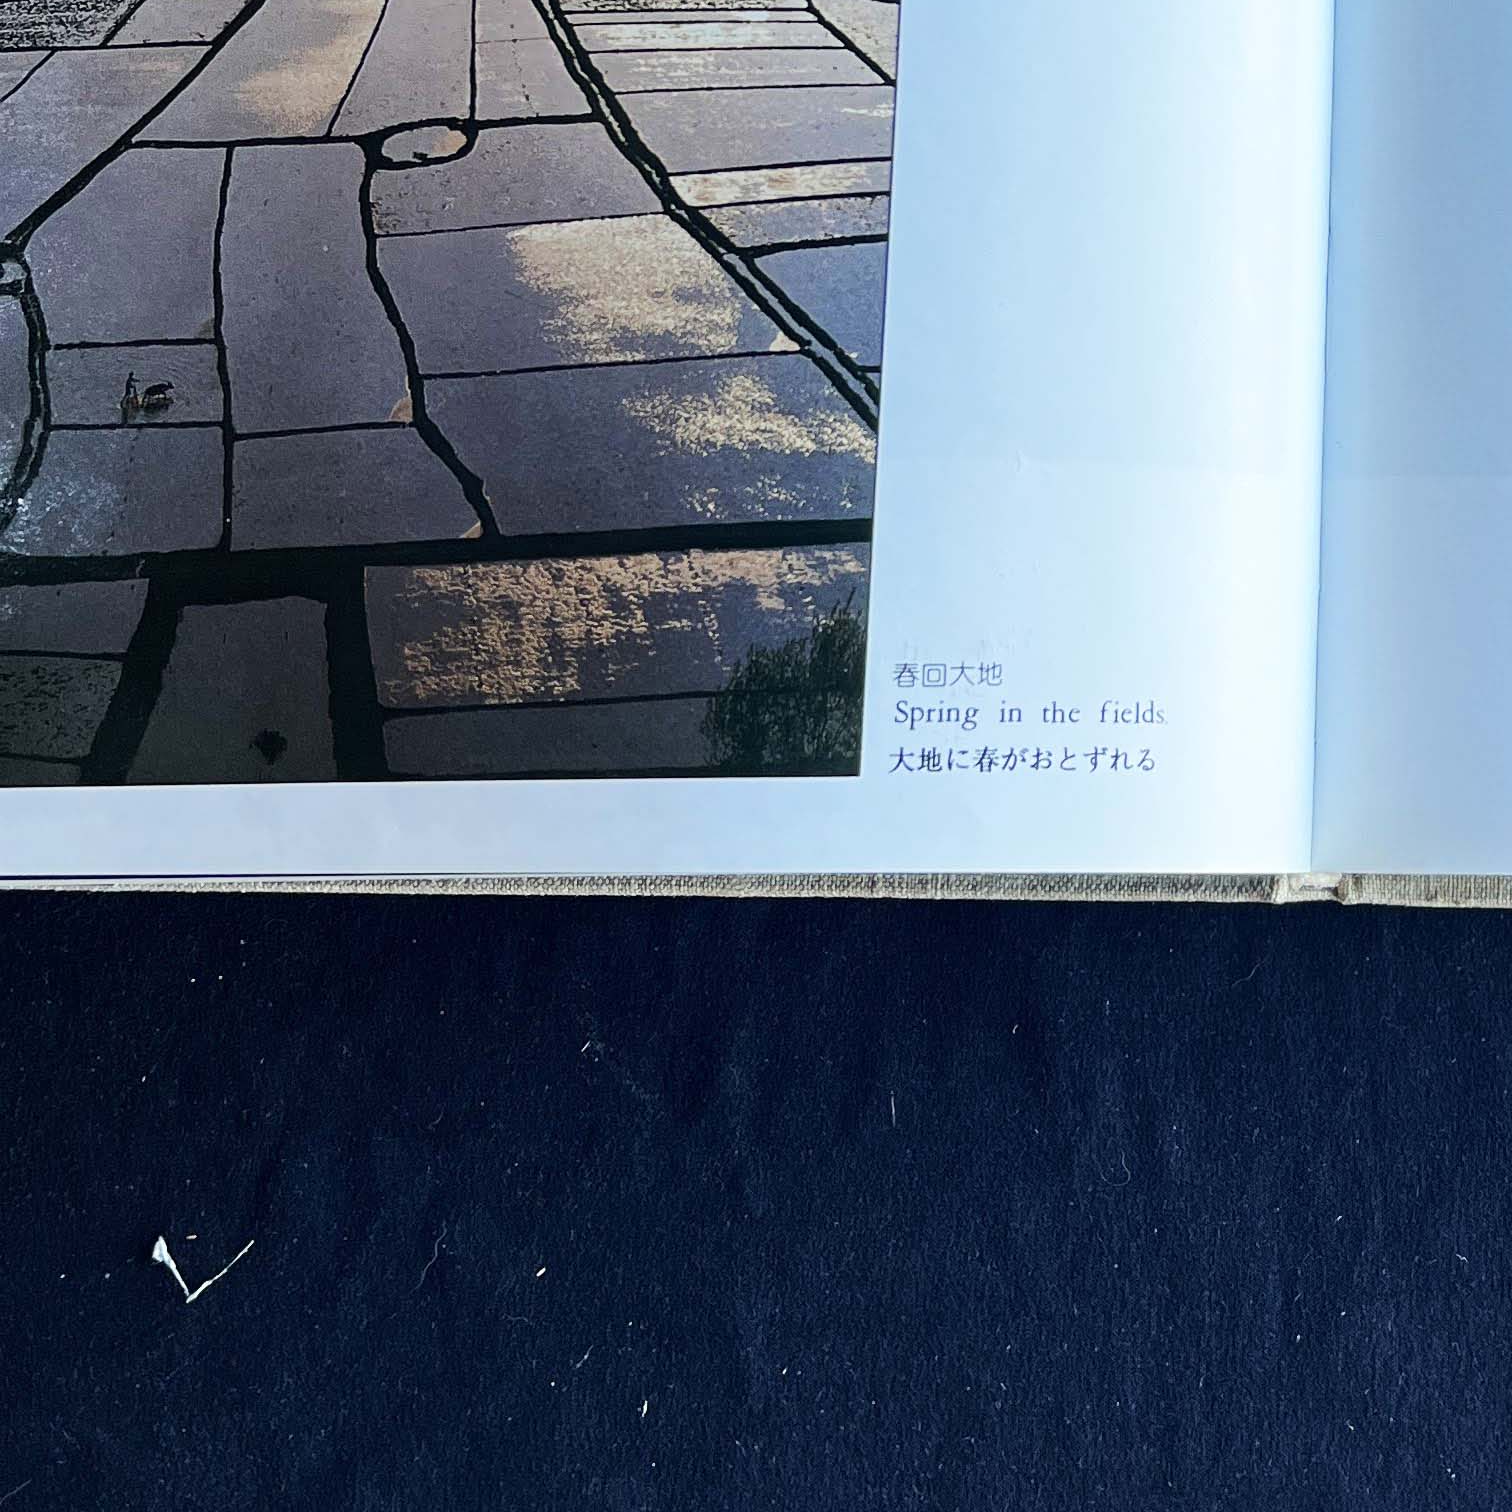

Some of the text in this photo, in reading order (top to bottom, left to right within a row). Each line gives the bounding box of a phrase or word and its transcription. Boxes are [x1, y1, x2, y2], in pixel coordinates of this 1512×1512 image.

[893, 661, 1003, 688] 春回大地
[894, 700, 980, 731] Spring
[999, 700, 1023, 723] in
[1042, 701, 1081, 724] the
[888, 746, 1156, 773] 大地に春がおとずれる
